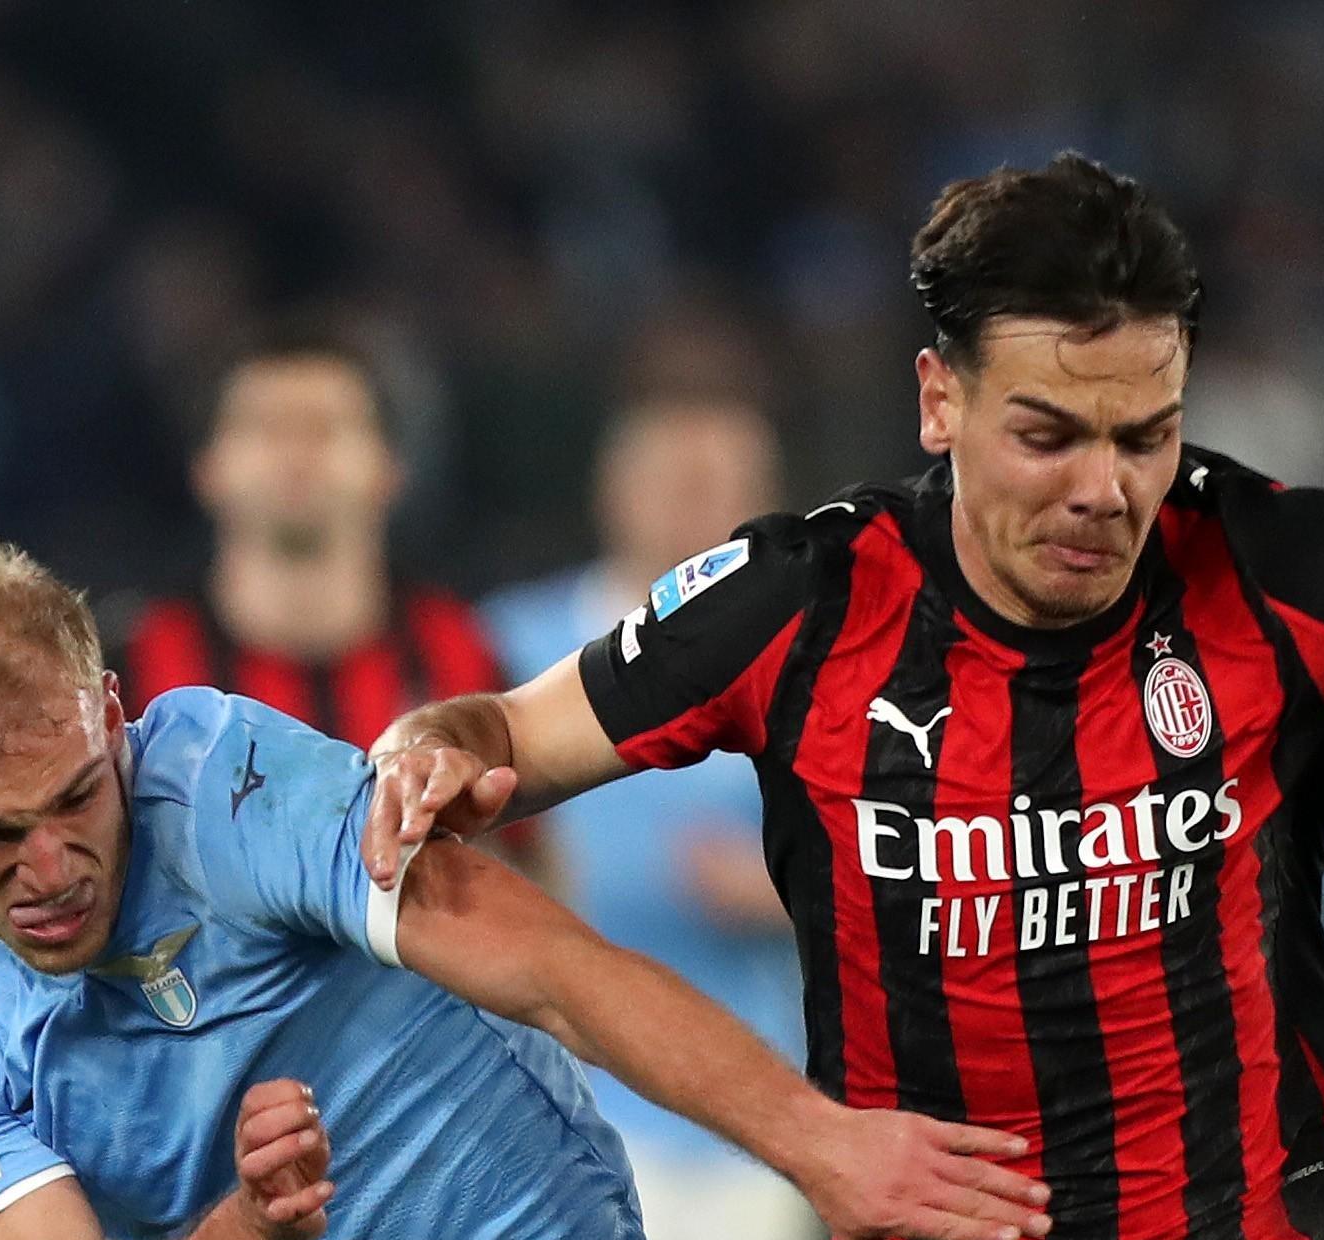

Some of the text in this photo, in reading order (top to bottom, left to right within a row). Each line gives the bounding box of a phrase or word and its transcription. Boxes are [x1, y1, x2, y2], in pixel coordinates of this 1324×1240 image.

[1170, 730, 1201, 747] 1899
[851, 778, 1244, 882] Emirates
[918, 863, 1195, 958] FLY BETTER
